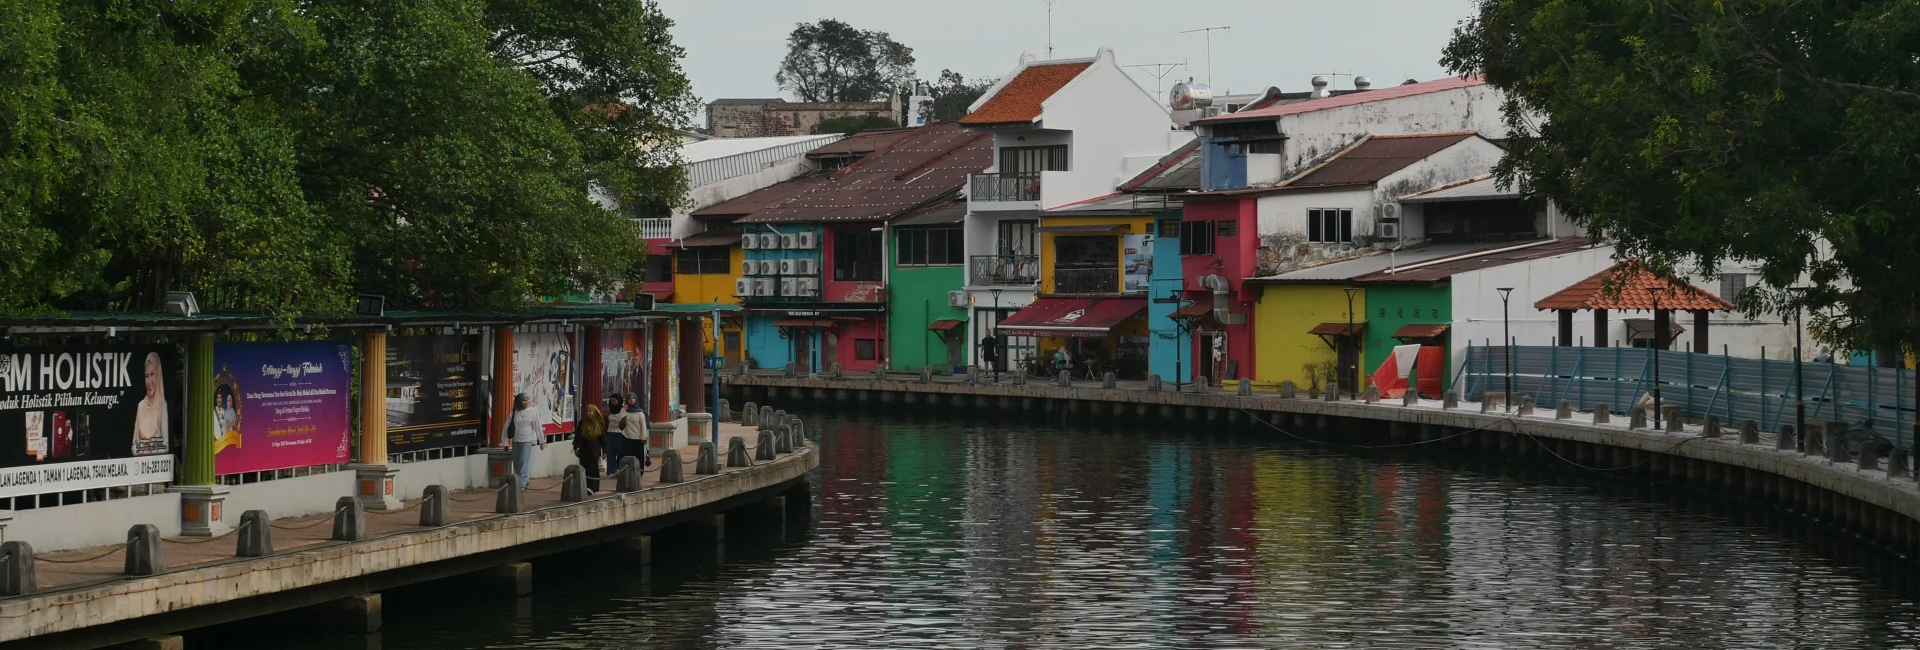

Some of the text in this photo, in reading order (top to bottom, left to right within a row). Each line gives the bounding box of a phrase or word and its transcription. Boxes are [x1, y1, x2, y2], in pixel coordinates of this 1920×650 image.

[39, 352, 132, 390] HOLISTIK
[302, 361, 322, 376] Tahniah
[21, 393, 53, 409] Holistik
[54, 392, 82, 407] Pilihan
[12, 470, 36, 486] LAGENDA
[44, 468, 61, 483] TAMAN
[93, 465, 106, 478] 75400
